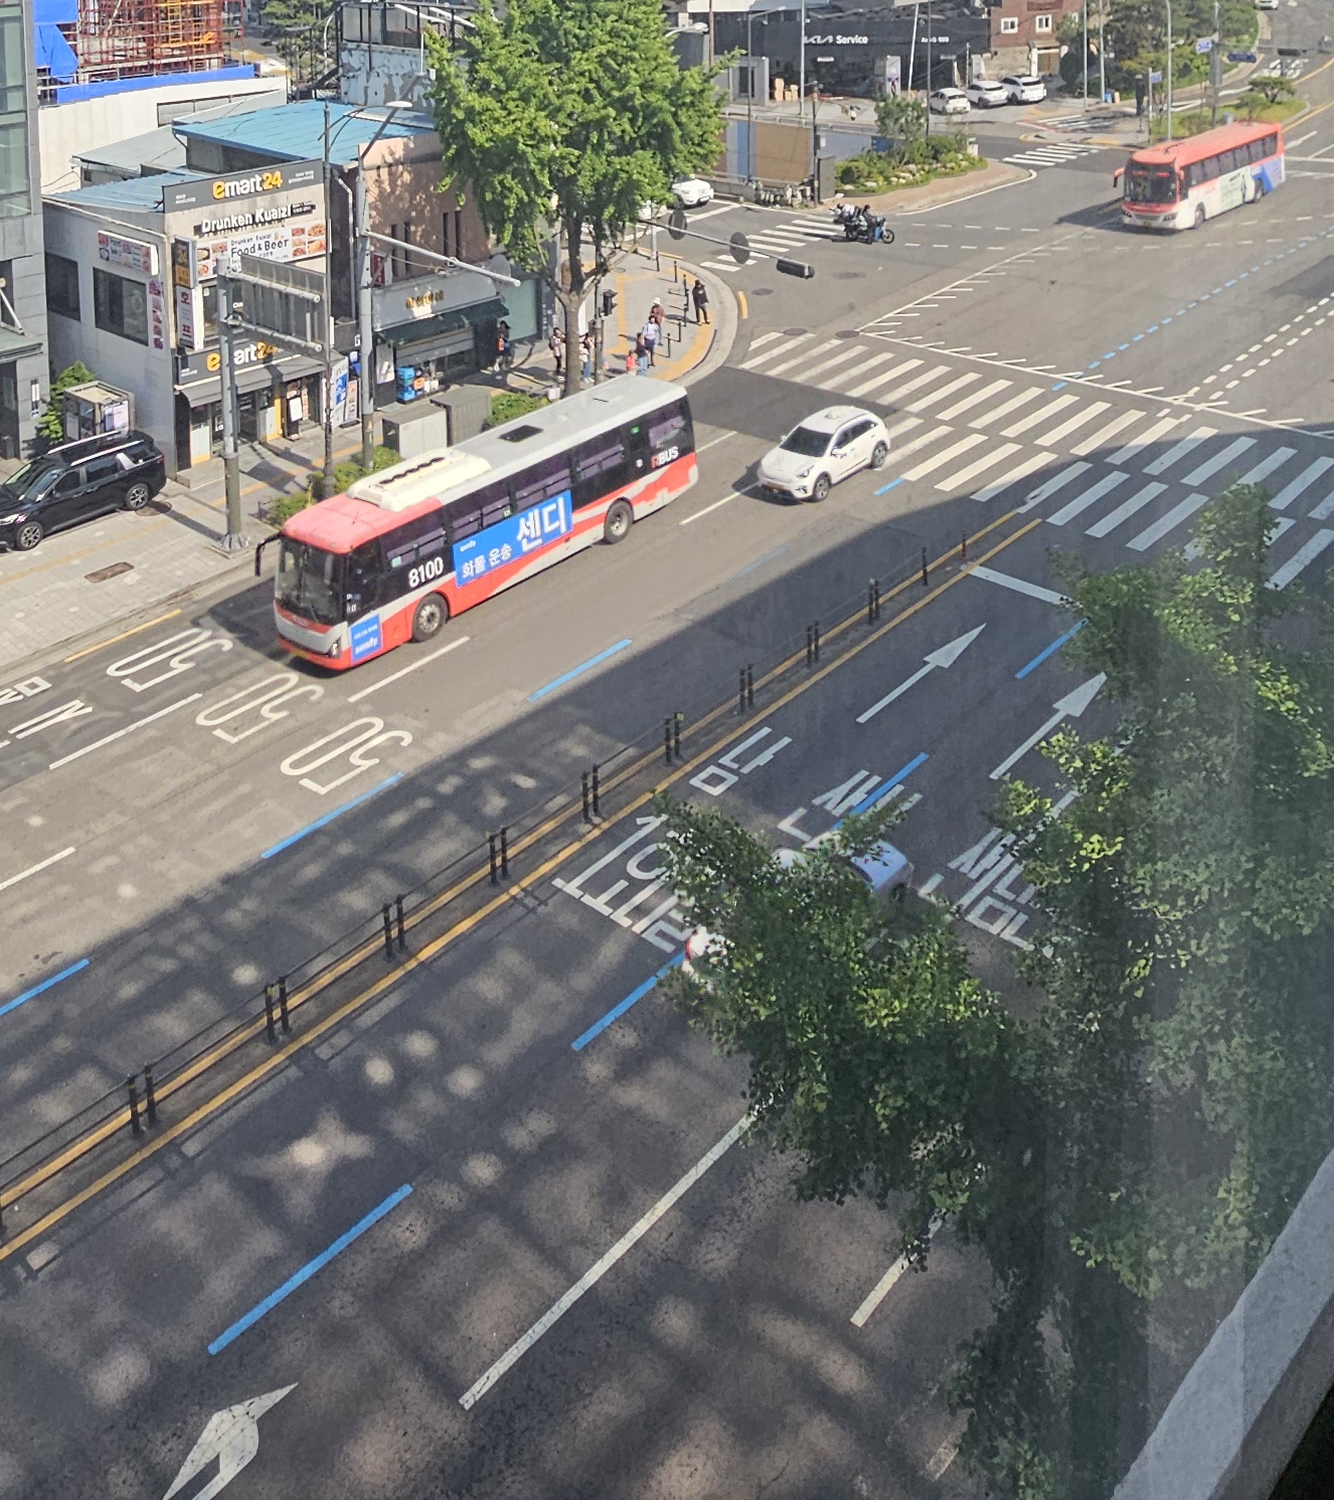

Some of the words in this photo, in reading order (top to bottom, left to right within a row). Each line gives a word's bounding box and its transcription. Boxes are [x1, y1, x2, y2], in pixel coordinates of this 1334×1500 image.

[836, 34, 869, 45] Service
[212, 170, 283, 200] emart24
[201, 213, 254, 234] Drunken
[231, 244, 256, 258] Food
[264, 238, 290, 251] Beer
[207, 341, 278, 372] eart24
[462, 555, 486, 579] 화물
[488, 543, 512, 567] 운송
[517, 496, 567, 552] 센디
[408, 556, 444, 587] 8100
